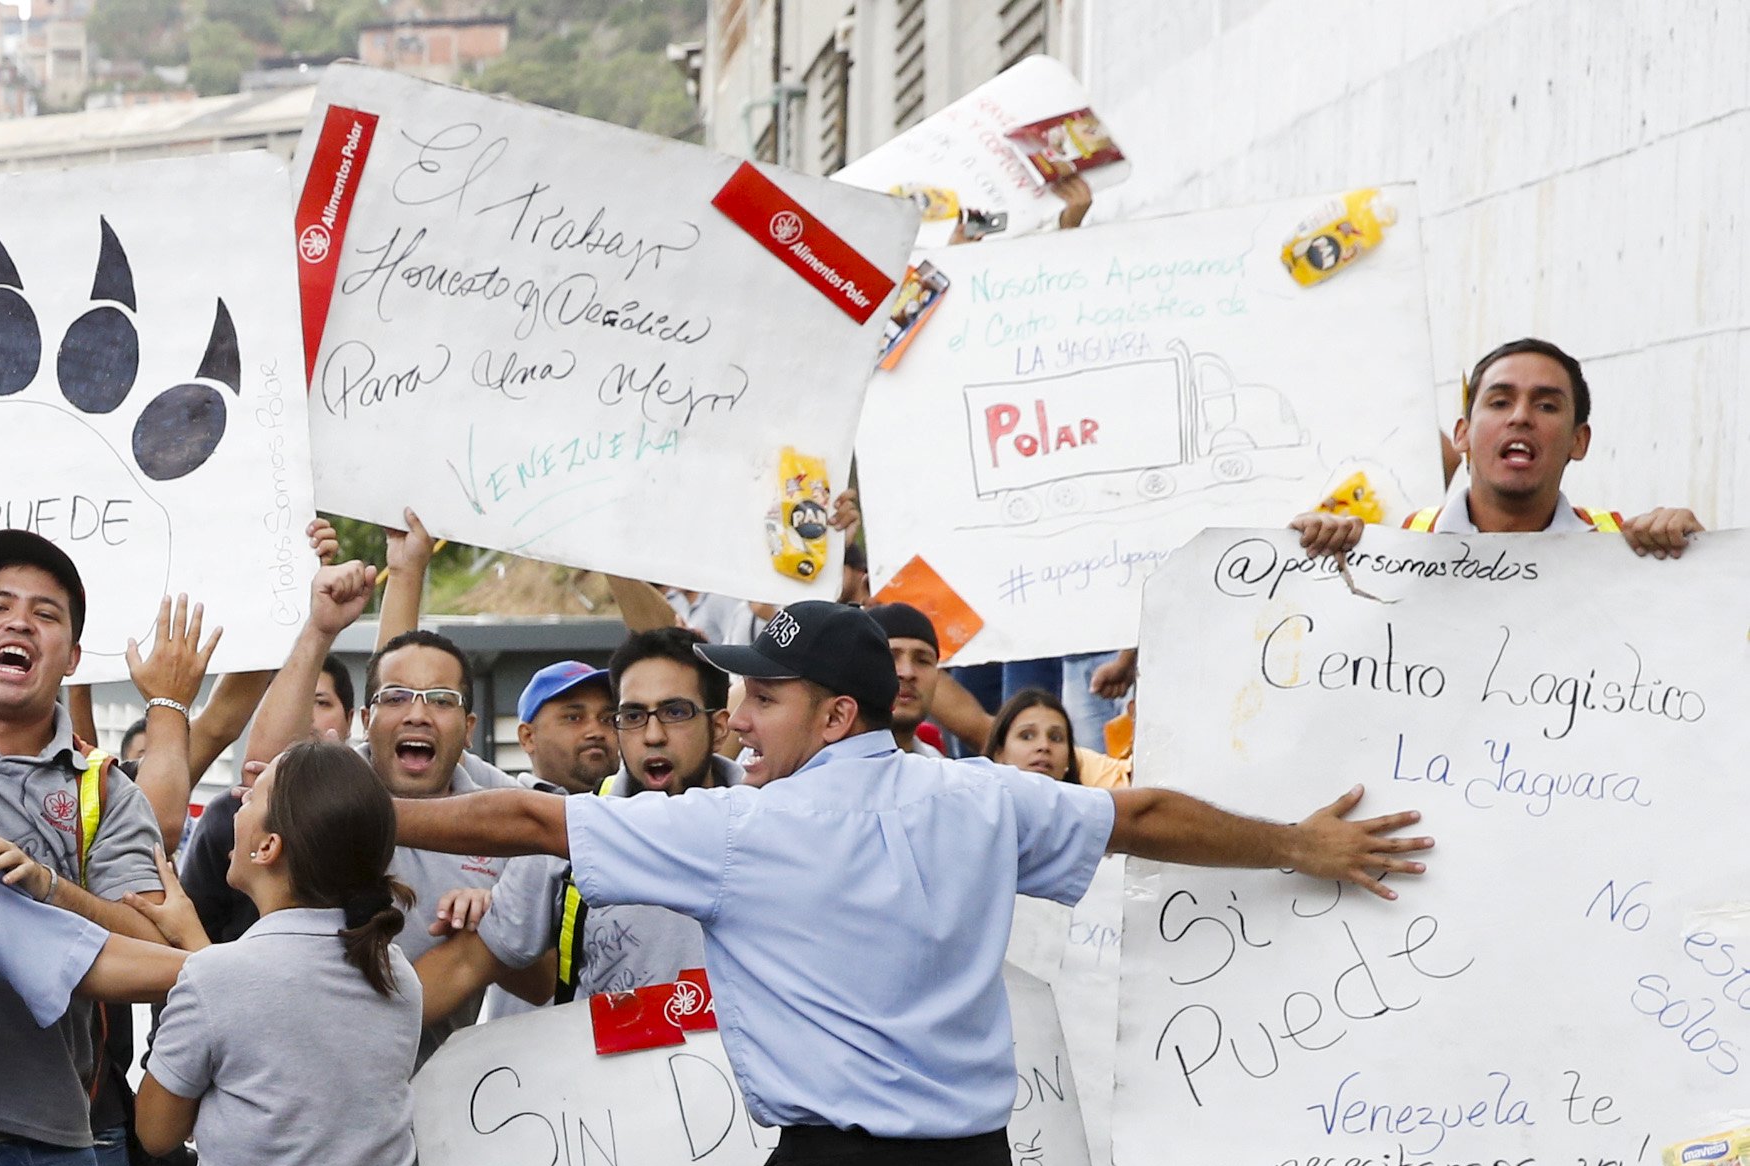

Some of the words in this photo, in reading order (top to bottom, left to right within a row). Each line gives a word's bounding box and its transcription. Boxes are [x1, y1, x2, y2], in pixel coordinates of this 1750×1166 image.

[321, 157, 352, 230] Alimentos
[341, 120, 364, 159] Polar
[788, 240, 845, 289] Alimentos
[838, 279, 871, 310] Polar
[970, 268, 1090, 303] Nosotros
[320, 340, 451, 419] Para
[1015, 345, 1046, 376] LA
[445, 421, 682, 516] VENEZUELA
[1261, 614, 1446, 699] Centro
[1481, 623, 1706, 740] Logistico
[1392, 733, 1456, 787] La
[1464, 738, 1653, 817] Yaguara
[1155, 914, 1476, 1107] Puede
[1306, 1071, 1537, 1156] Venezuela
[1561, 1070, 1622, 1125] te
[1683, 1145, 1728, 1163] mavesa
